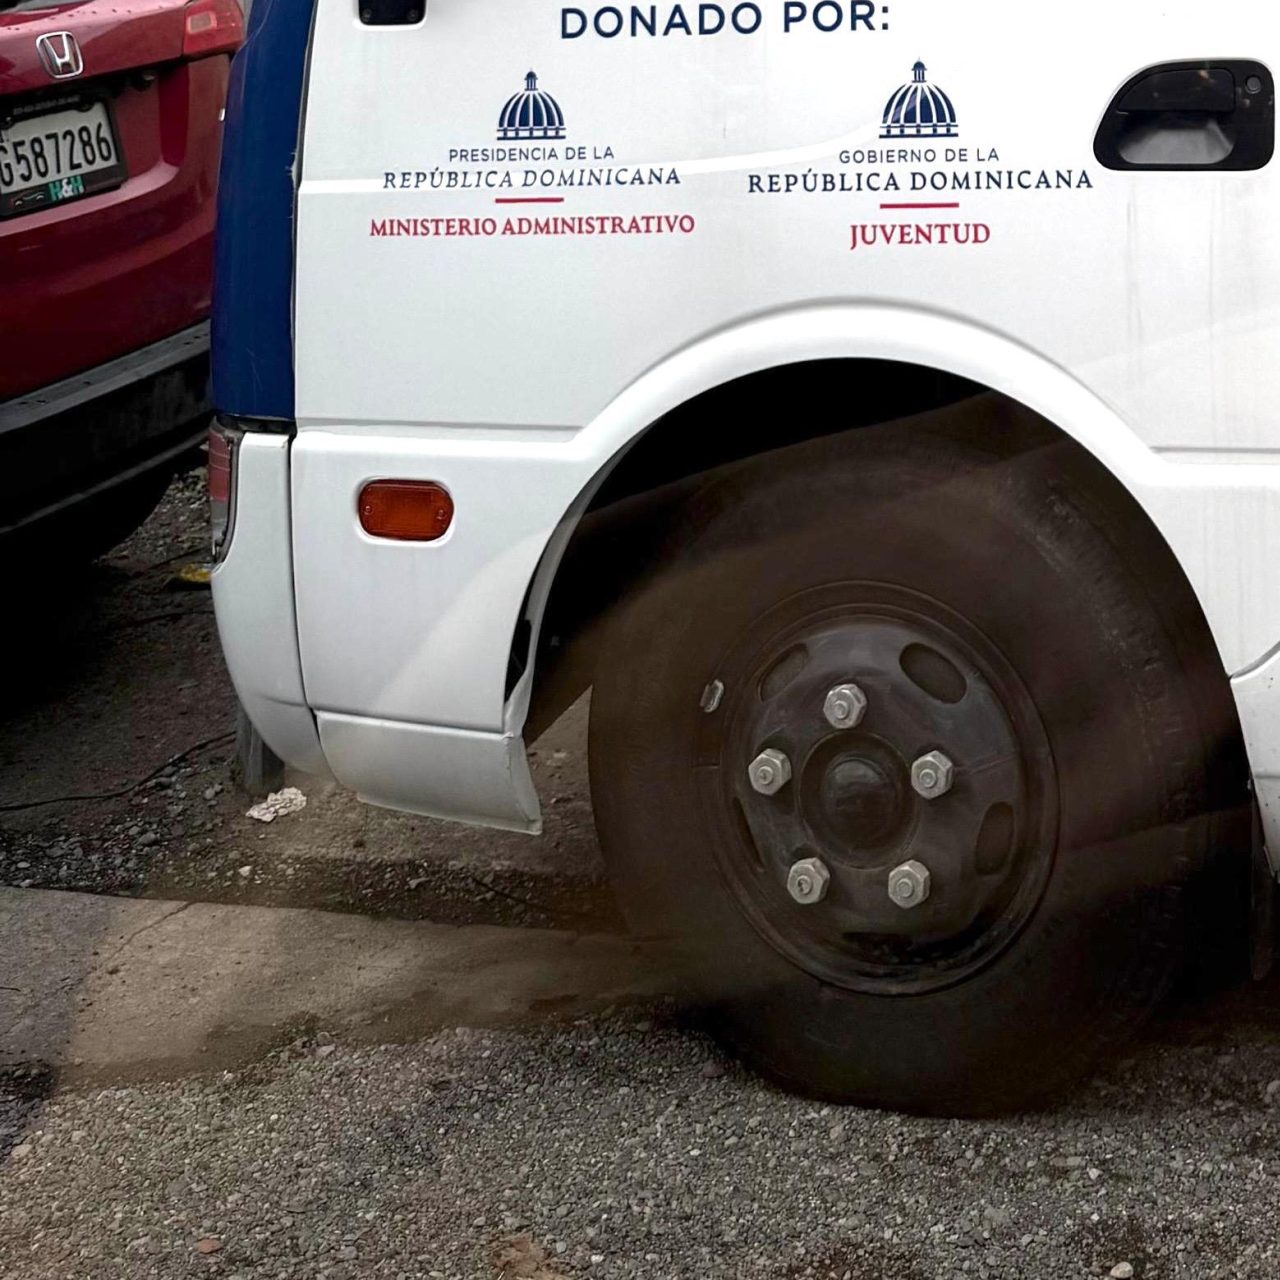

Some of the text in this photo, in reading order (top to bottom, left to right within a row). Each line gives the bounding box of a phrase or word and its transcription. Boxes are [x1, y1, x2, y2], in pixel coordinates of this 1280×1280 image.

[560, 0, 890, 39] DONADO POR:
[449, 146, 615, 162] PRESIDENCIA DE LA
[839, 147, 1000, 164] GOBIERNO DE LA
[383, 166, 681, 189] REPÚBLICA DOMINICANA
[748, 168, 1093, 193] REPÚBLICA DOMINICANA
[370, 215, 695, 236] MINISTERIO ADMINISTRATIVO
[850, 223, 990, 250] JUVENTUD
